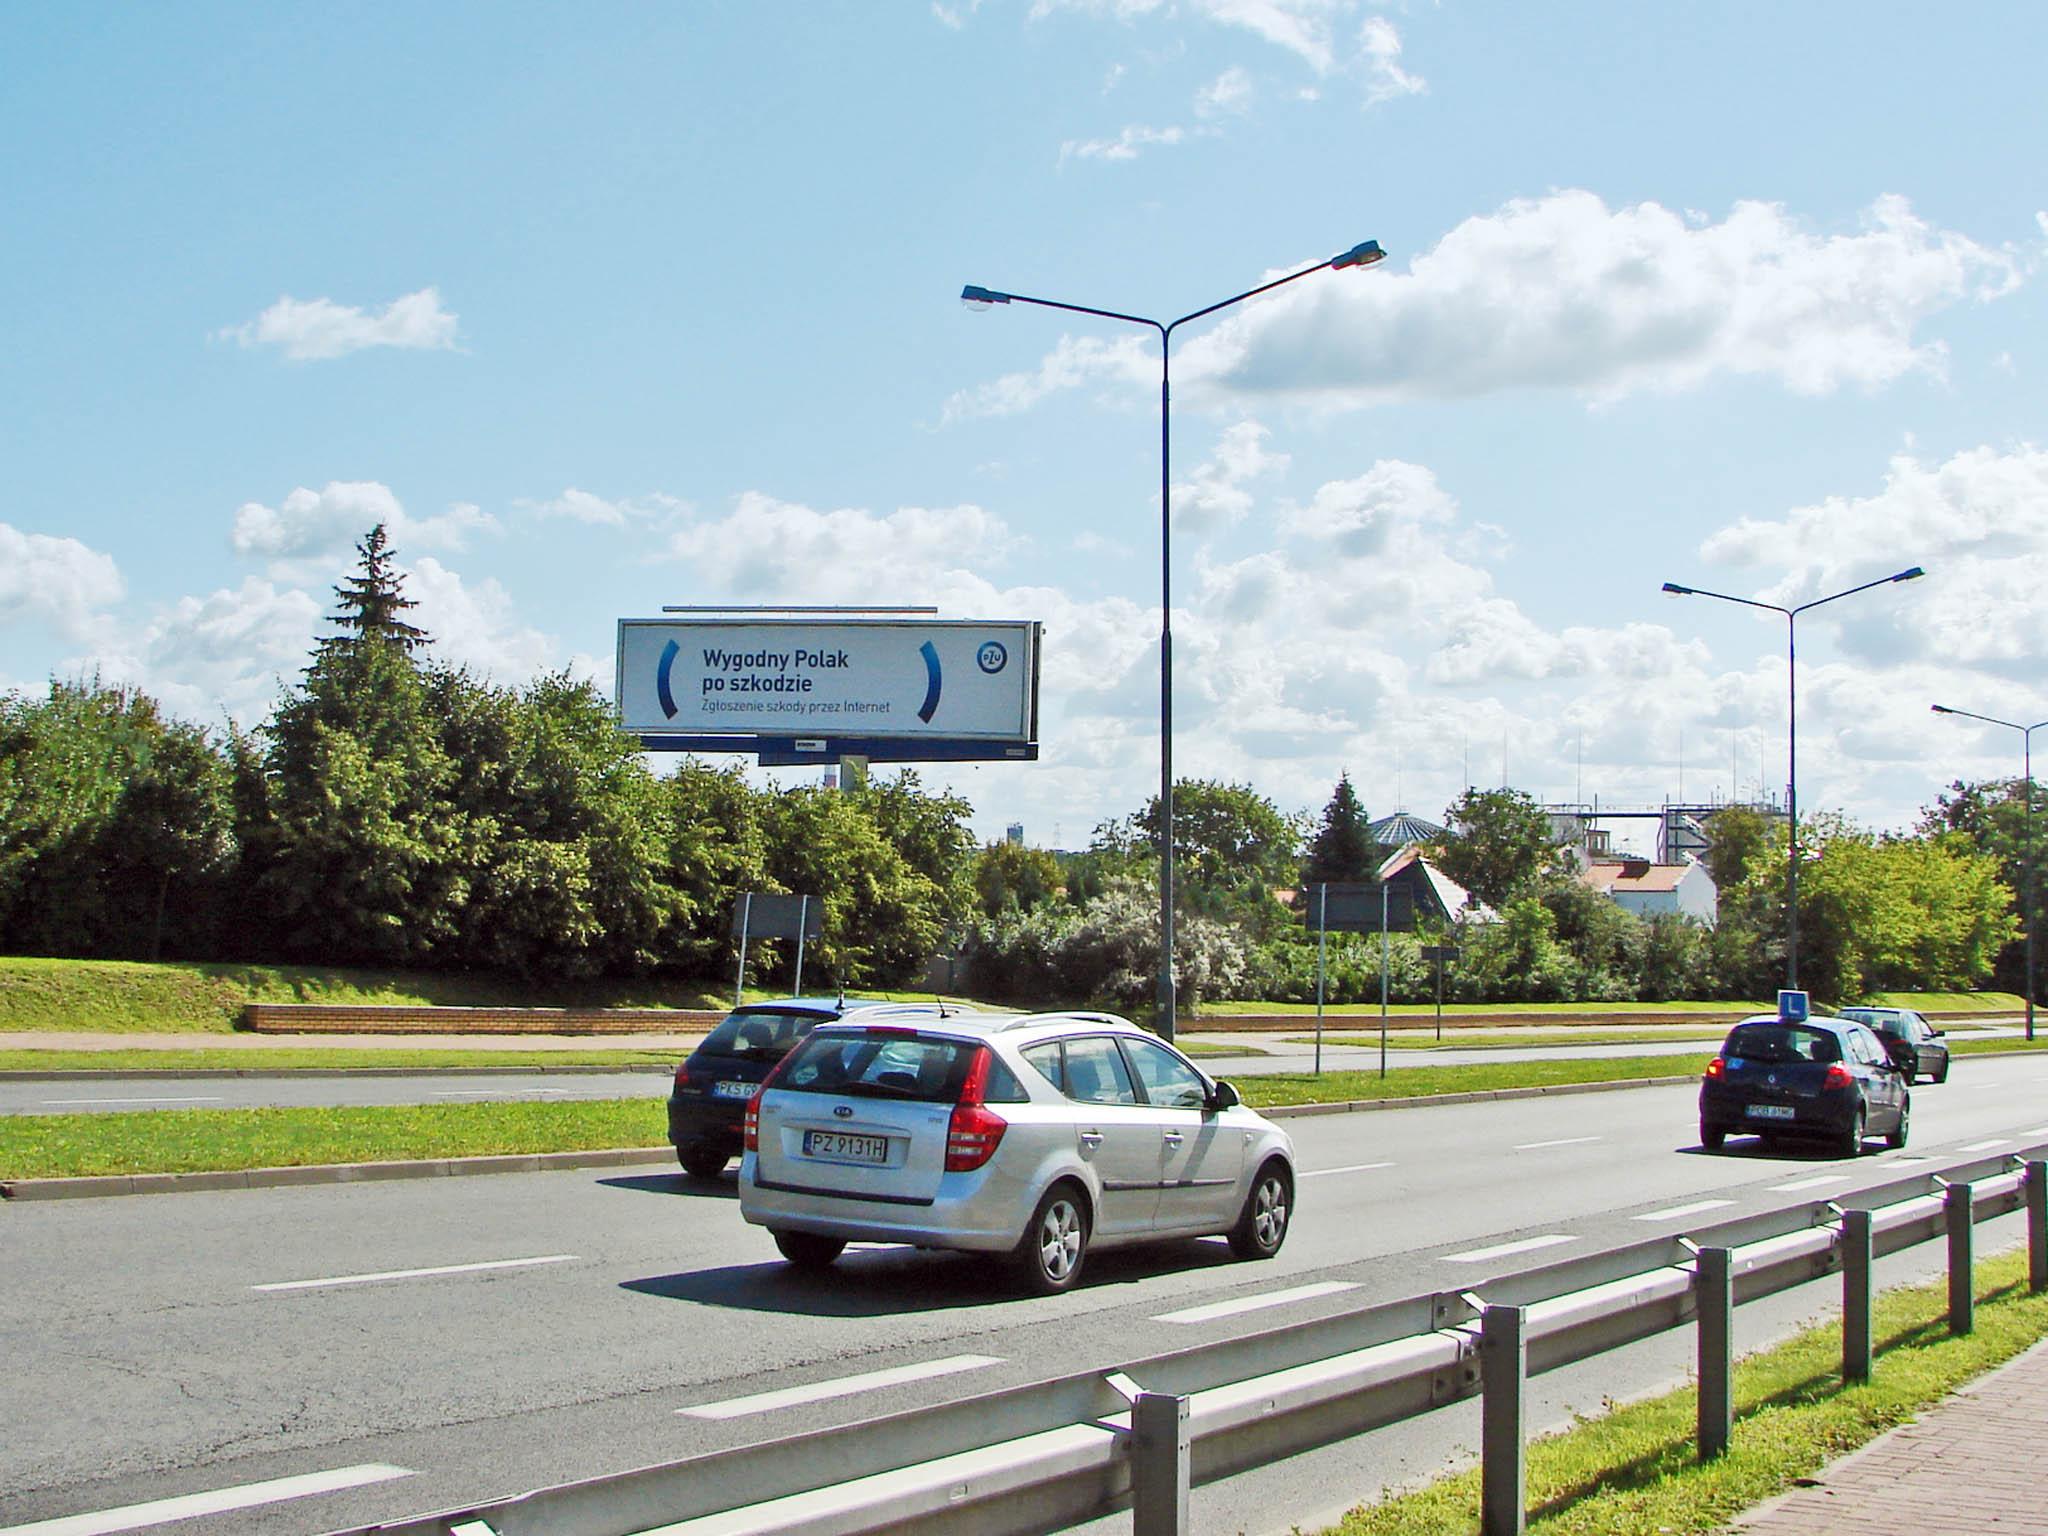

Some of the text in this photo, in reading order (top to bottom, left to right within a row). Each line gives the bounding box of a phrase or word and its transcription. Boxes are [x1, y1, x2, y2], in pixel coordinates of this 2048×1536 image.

[703, 649, 849, 671] Wygodny Polak
[702, 674, 812, 695] po szkodzie
[766, 701, 806, 714] szkody
[808, 703, 841, 715] przez
[843, 700, 890, 713] Internet
[1788, 995, 1801, 1014] L
[812, 1134, 884, 1157] PZ 9131H
